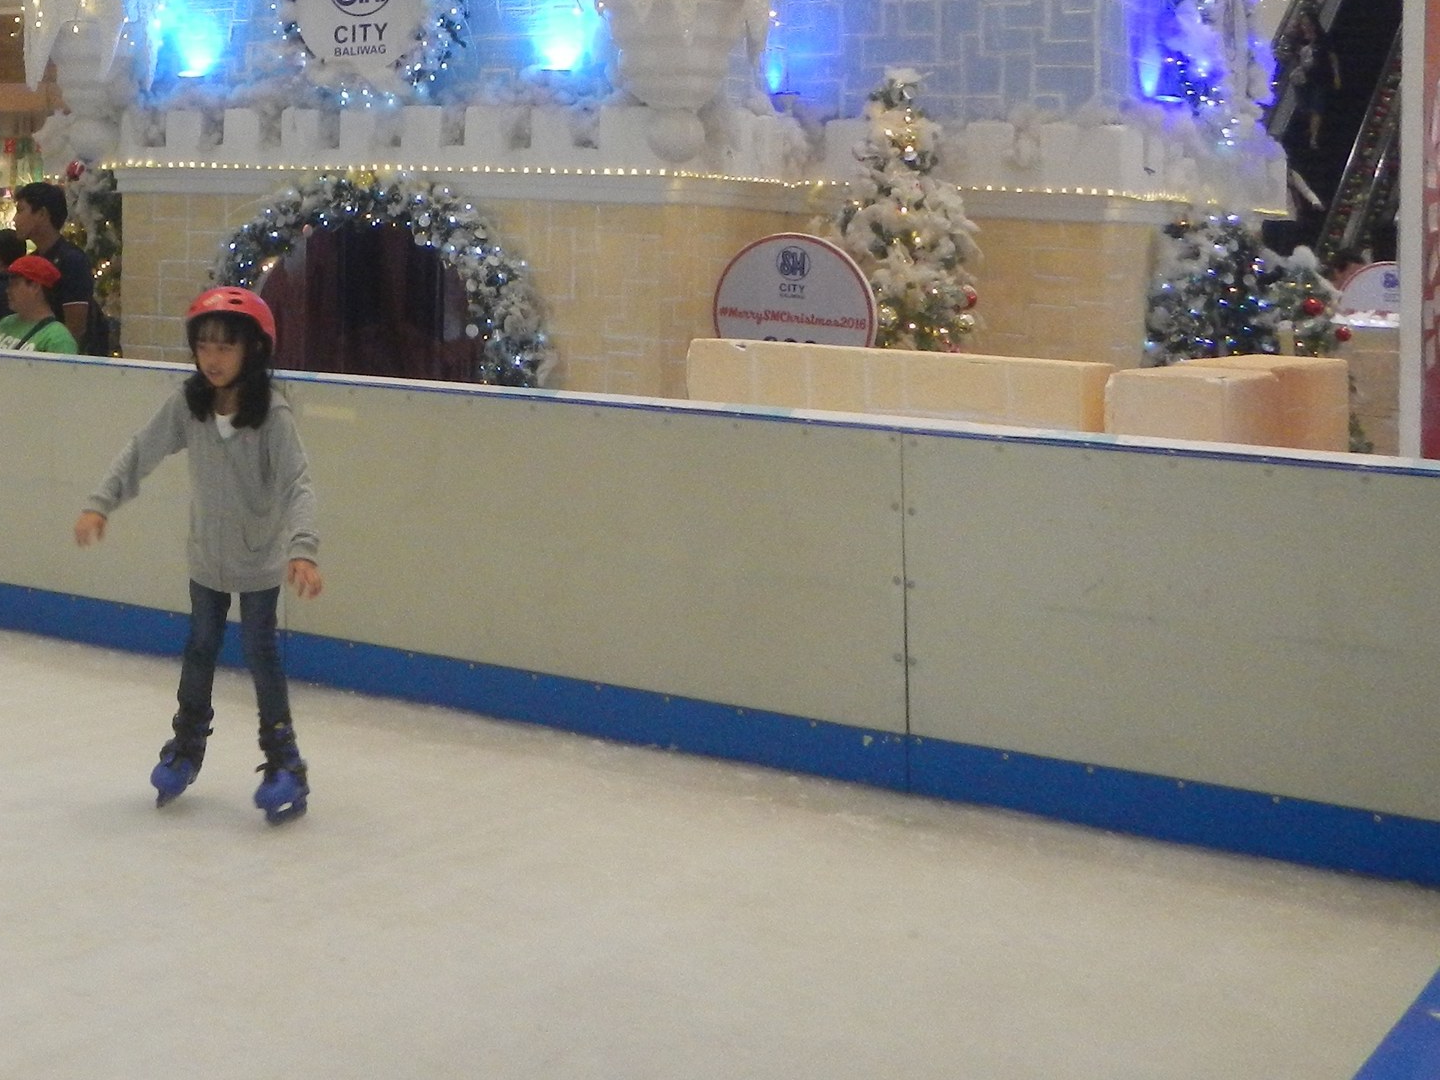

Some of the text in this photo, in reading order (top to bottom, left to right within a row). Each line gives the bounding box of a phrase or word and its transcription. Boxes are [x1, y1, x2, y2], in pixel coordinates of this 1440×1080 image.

[334, 23, 388, 44] CITY
[334, 44, 387, 57] BALIWAG
[780, 250, 806, 276] SM
[779, 283, 806, 293] CITY
